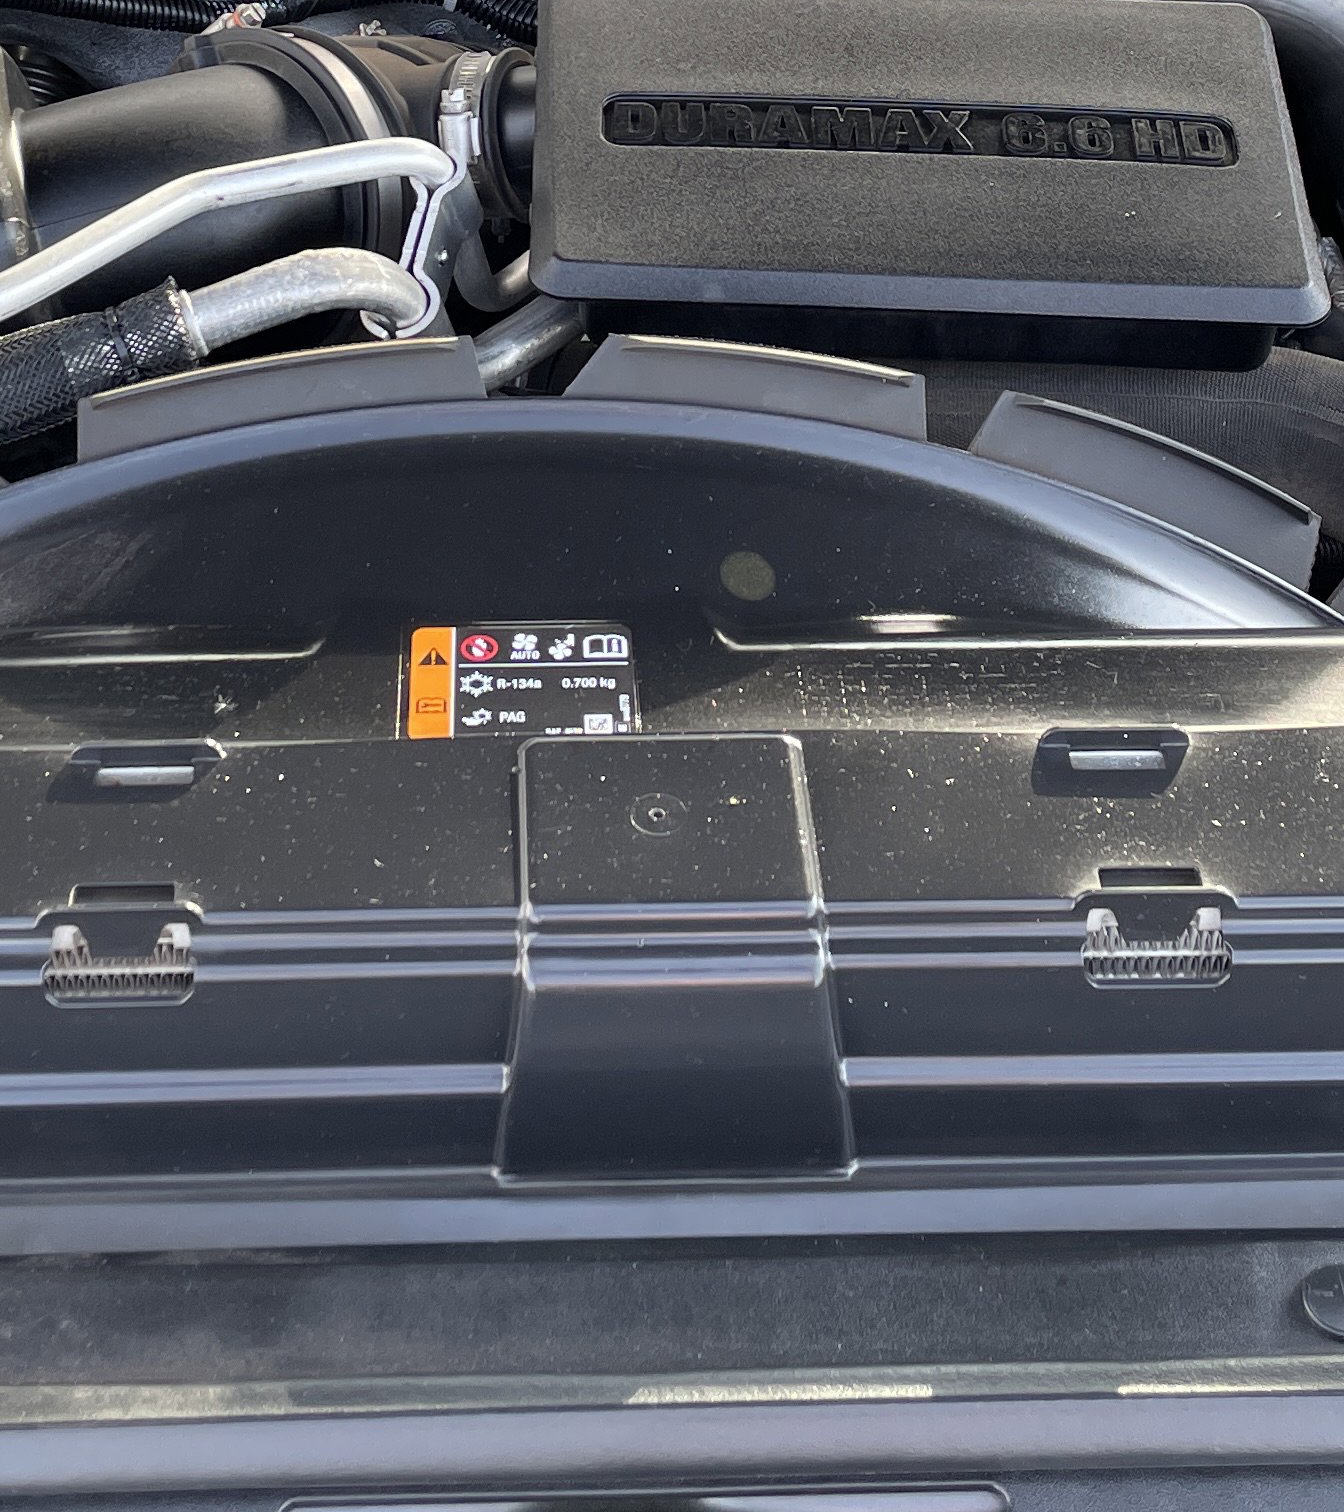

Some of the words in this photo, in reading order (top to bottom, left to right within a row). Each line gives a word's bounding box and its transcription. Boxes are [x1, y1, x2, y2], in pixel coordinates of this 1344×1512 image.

[614, 100, 974, 154] DURAMAX
[1003, 115, 1115, 158] 6.6
[1132, 119, 1229, 164] HD
[510, 650, 540, 660] AUTO
[496, 677, 543, 690] R-134a
[561, 677, 597, 690] 0.700
[599, 677, 616, 691] kg
[498, 711, 527, 724] PAG
